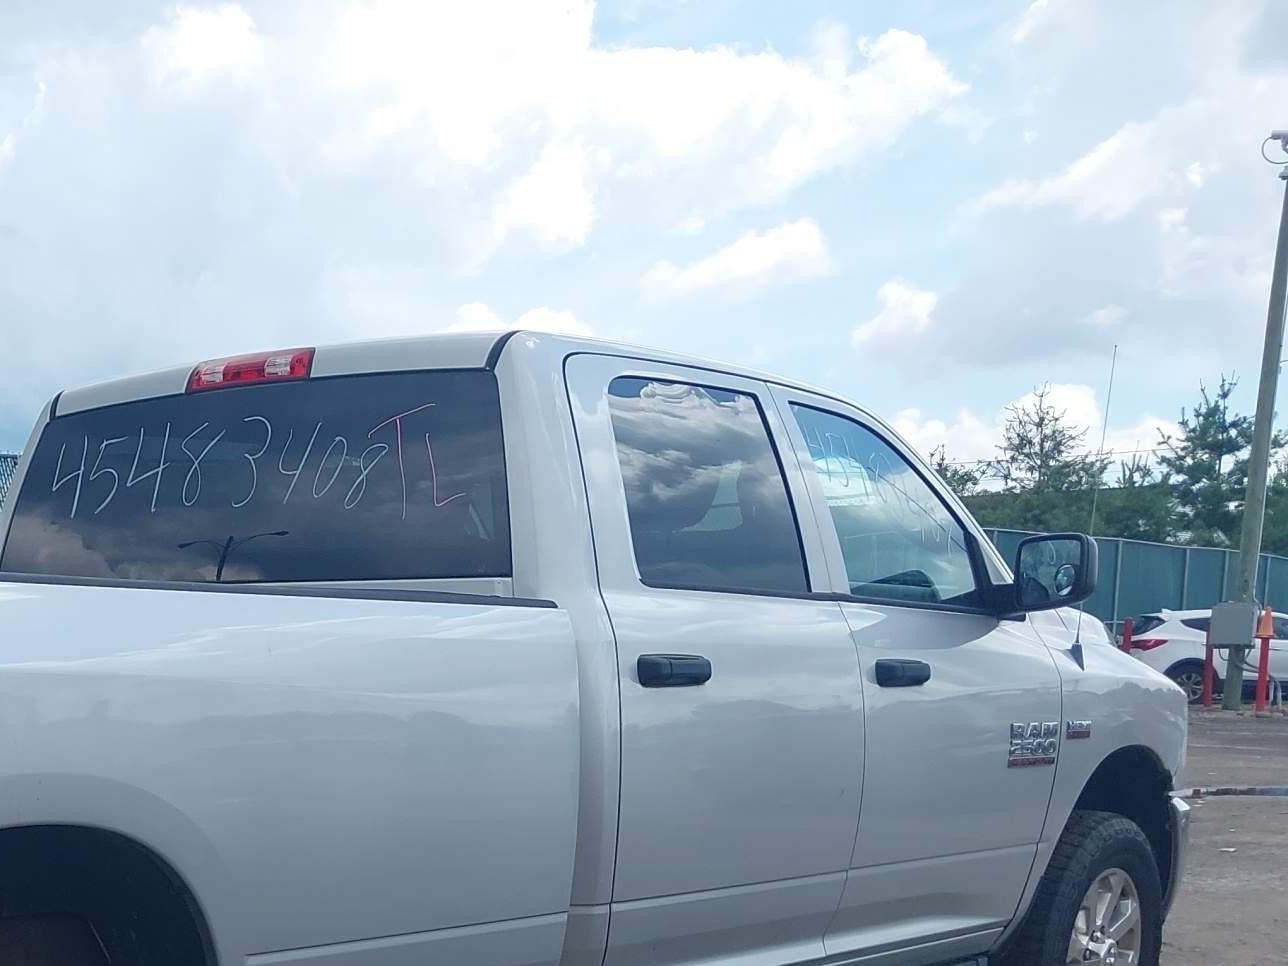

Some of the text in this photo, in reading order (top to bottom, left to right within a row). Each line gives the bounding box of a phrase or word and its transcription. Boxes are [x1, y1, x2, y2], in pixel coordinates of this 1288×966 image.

[51, 416, 391, 520] 45483408
[1010, 721, 1059, 739] RAM
[1009, 738, 1057, 755] 2500
